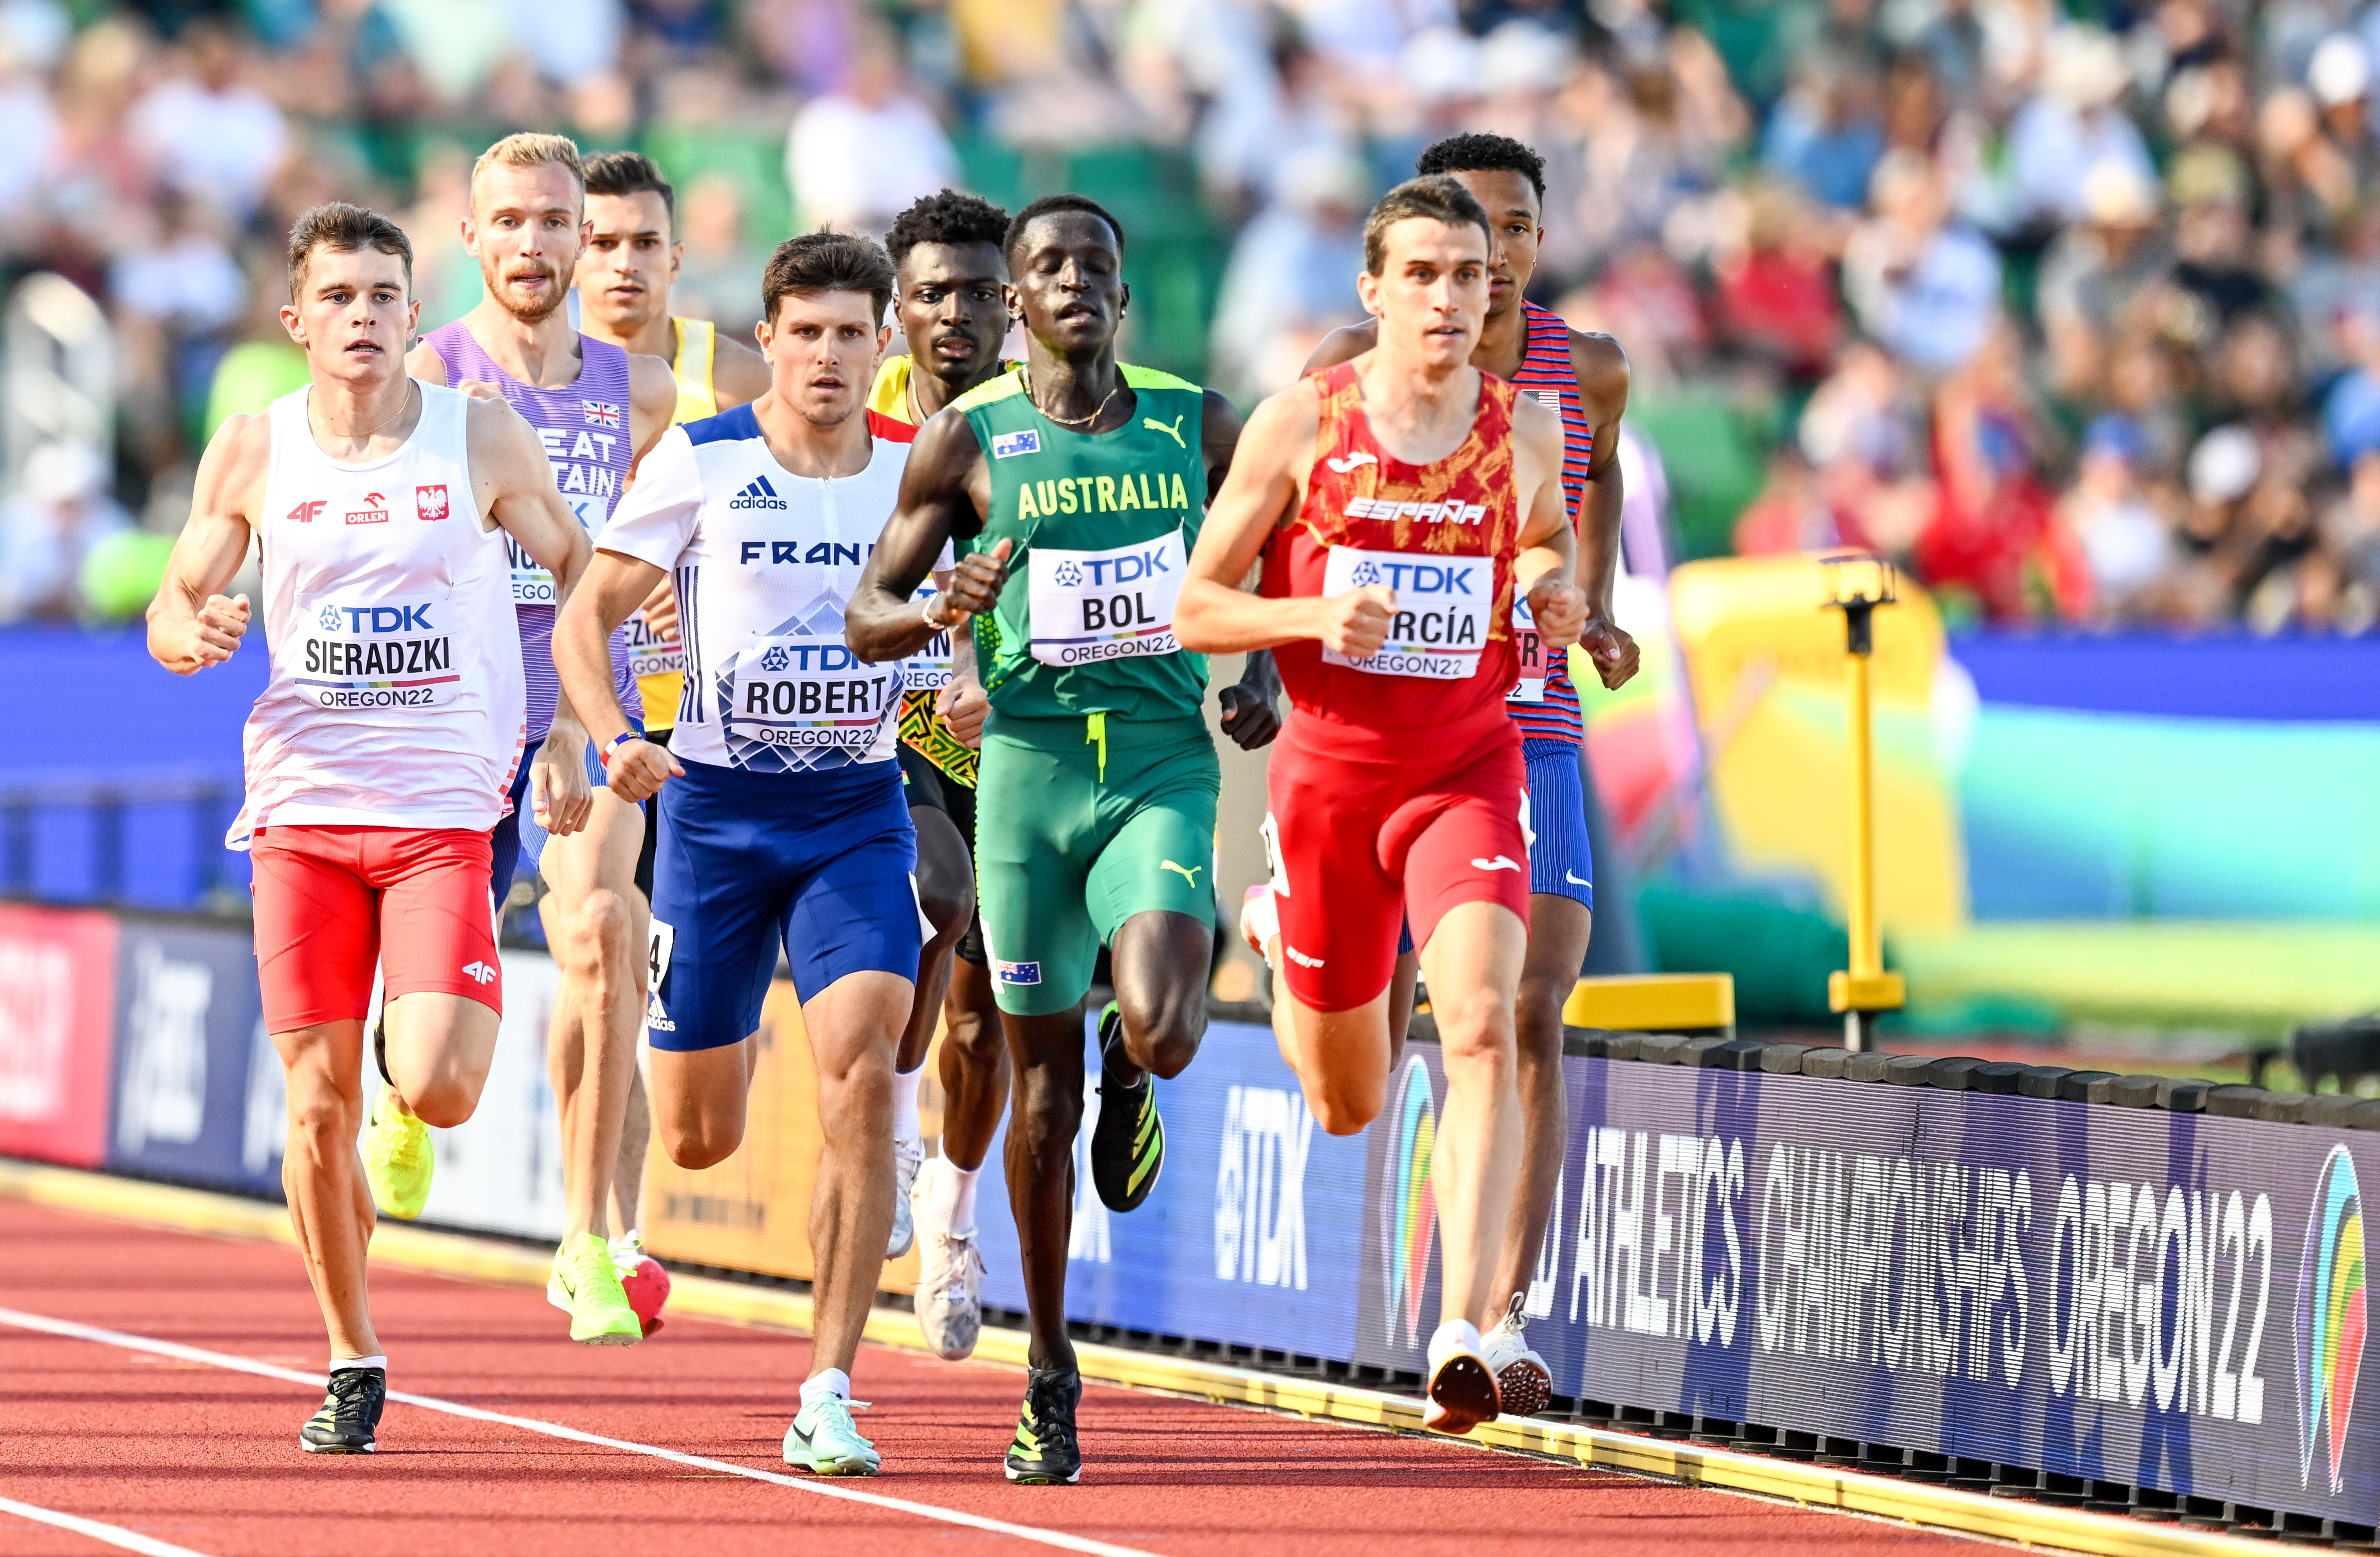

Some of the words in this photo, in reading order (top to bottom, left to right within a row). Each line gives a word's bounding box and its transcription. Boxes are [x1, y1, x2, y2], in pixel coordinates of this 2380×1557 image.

[537, 428, 616, 462] EAT
[550, 462, 616, 497] TAIN
[287, 501, 327, 522] 4F
[730, 497, 787, 510] adidas
[1018, 474, 1188, 519] AUSTRALIA
[1343, 497, 1486, 525] ESPAÑA
[347, 512, 387, 523] ORLEN
[741, 541, 875, 565] FRAN
[1082, 545, 1169, 586] TDK
[1382, 563, 1473, 595] TDK
[341, 603, 434, 633] TDK
[1083, 592, 1156, 631] BOL
[1385, 606, 1475, 644] RCÍA
[305, 636, 450, 675] SIERADZKI
[1061, 634, 1176, 663] OREGON22
[320, 688, 434, 707] OREGON22
[748, 676, 887, 714] ROBERT
[760, 729, 873, 745] OREGON22
[462, 961, 496, 986] 4F
[1570, 1126, 1745, 1348] ATHLETICS
[1758, 1141, 2032, 1389] CHAMPIONSHIPS
[2049, 1173, 2272, 1425] OREGON22
